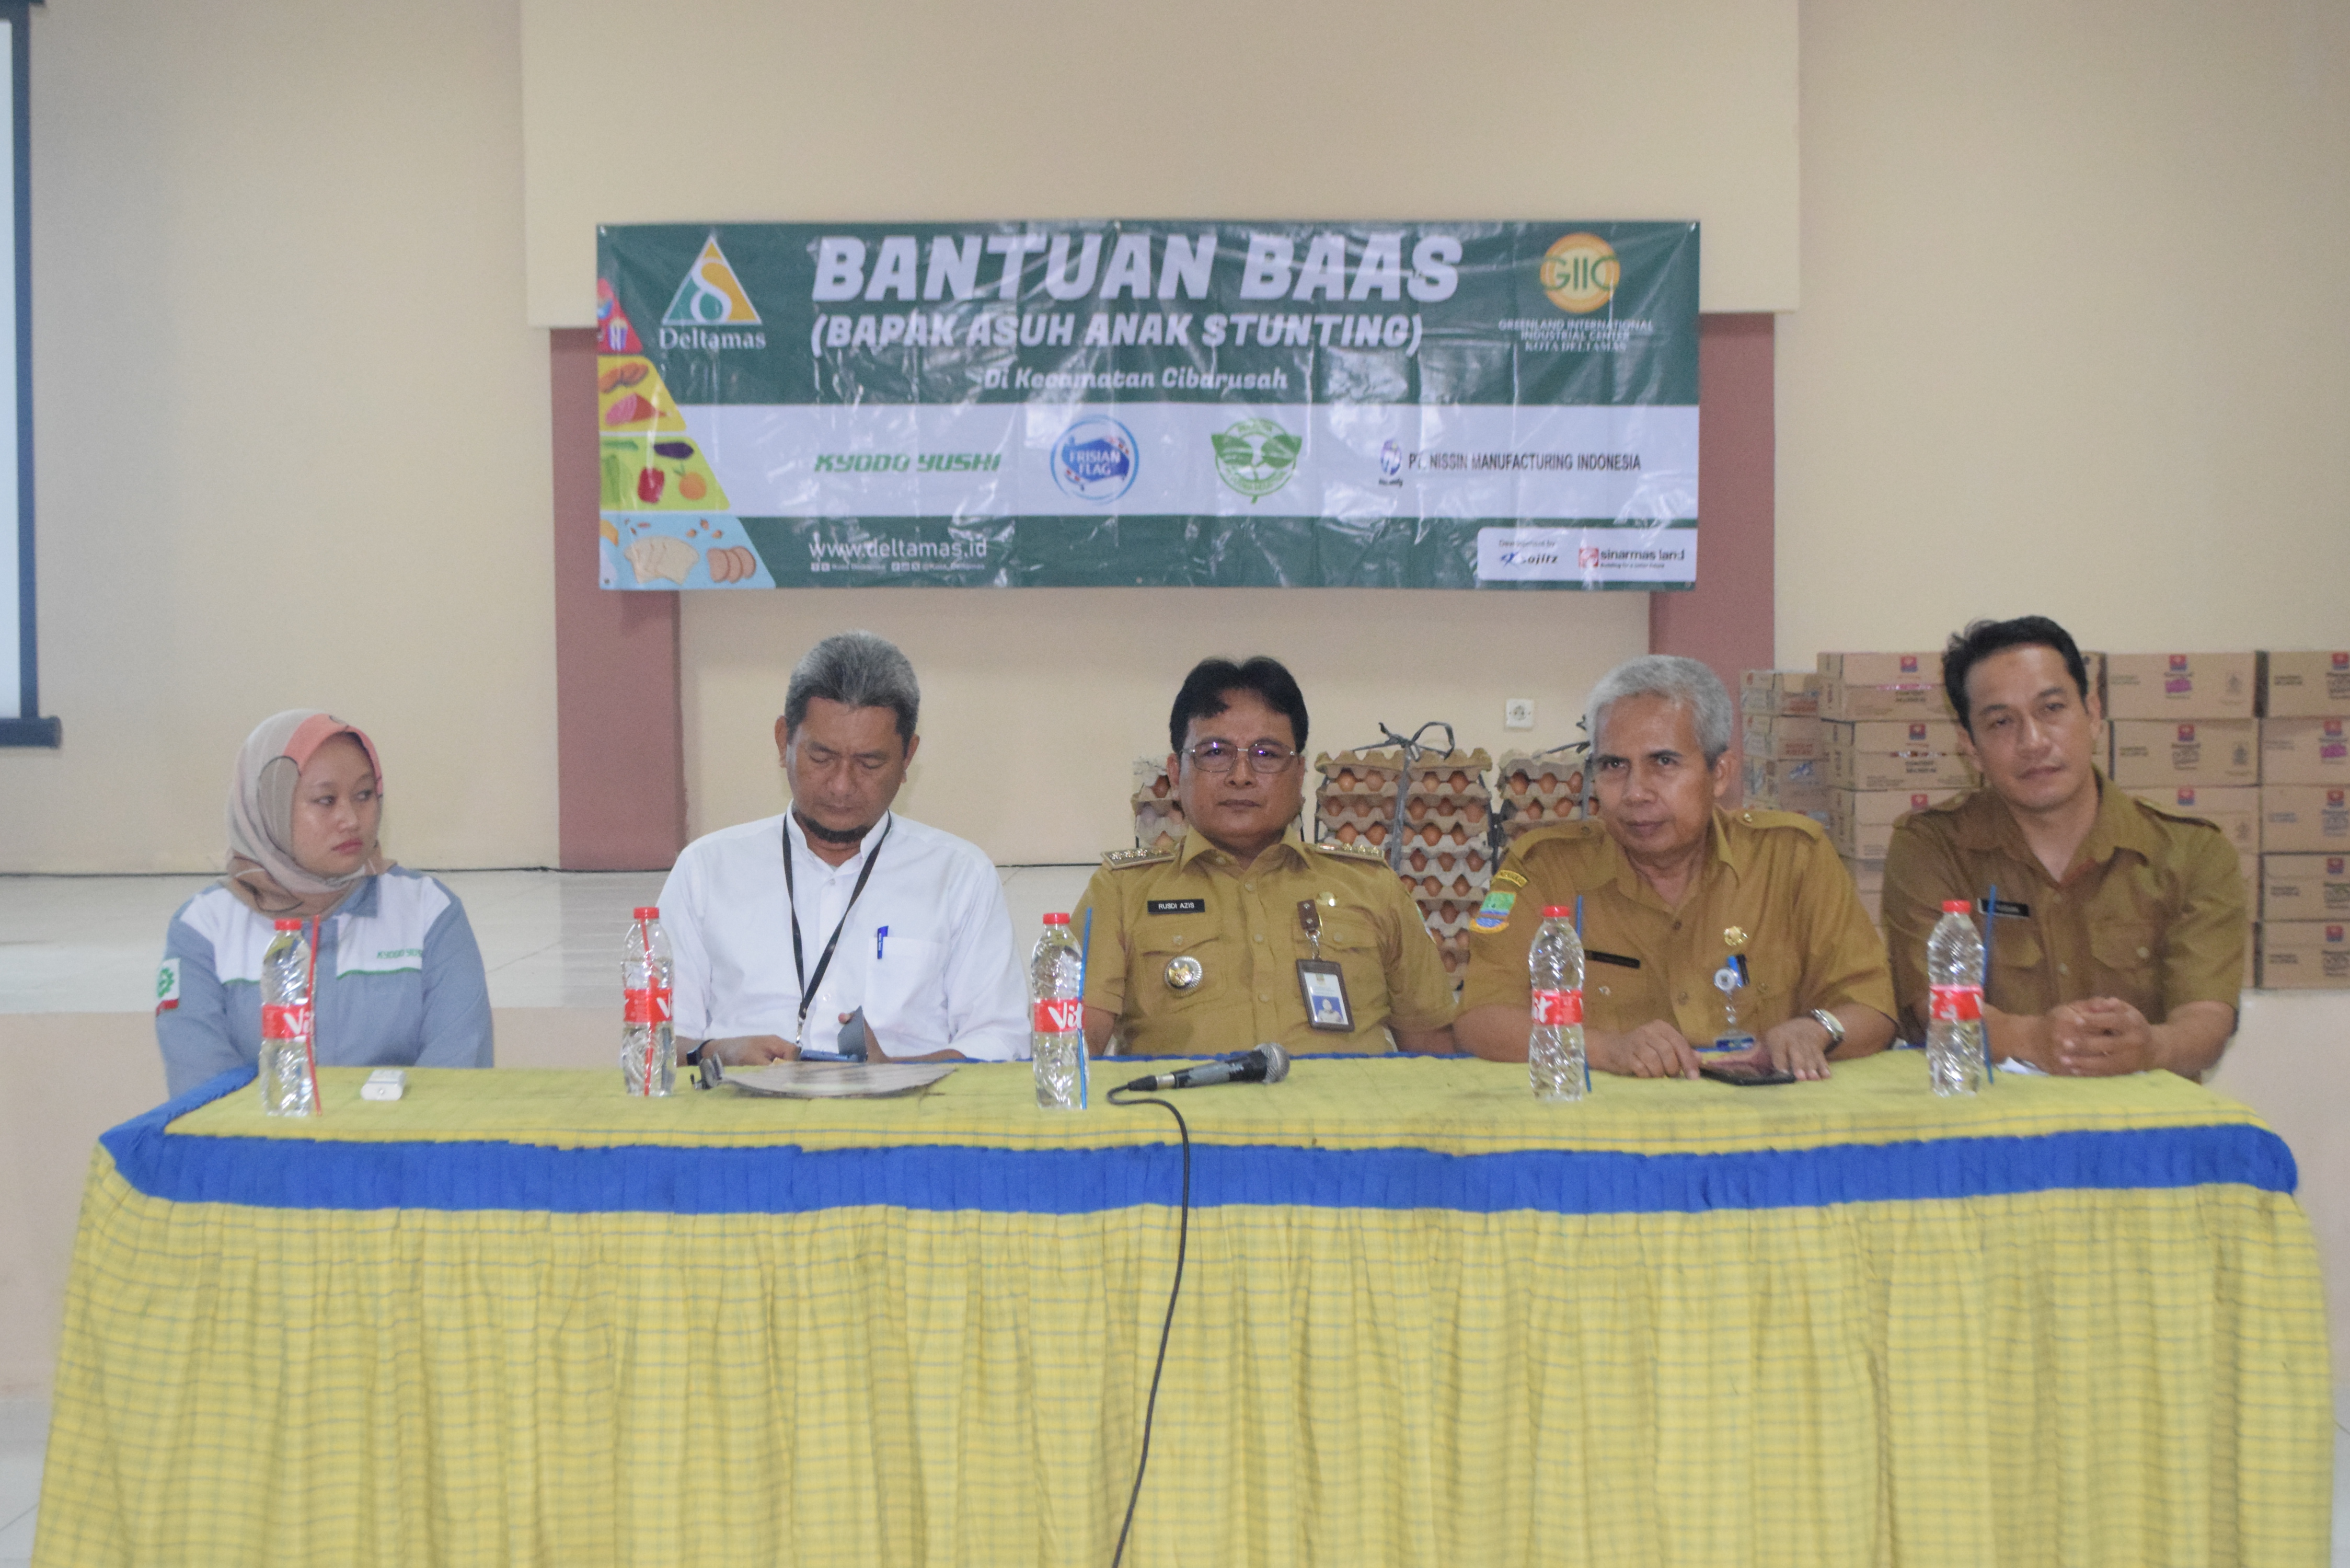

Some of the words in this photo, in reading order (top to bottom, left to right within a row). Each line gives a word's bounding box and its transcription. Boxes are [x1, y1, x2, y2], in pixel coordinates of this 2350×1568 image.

[812, 234, 1217, 302] BANTUAN
[1239, 232, 1462, 303] BAAS
[1542, 255, 1617, 291] GIIC
[660, 327, 767, 350] Deltamas
[811, 314, 954, 358] (BAPAK
[967, 314, 1075, 347] ASUH
[1085, 313, 1194, 347] ANAK
[1202, 314, 1423, 358] STUNTING)
[984, 367, 1008, 389] Di
[1015, 367, 1155, 389] Kecamatan
[1161, 367, 1288, 389] Cibarusah
[814, 454, 911, 472] KYODO
[917, 453, 1001, 472] YUSHI
[1430, 453, 1467, 470] NISSIN
[1471, 453, 1573, 470] MANUFACTURING
[1576, 453, 1642, 470] INDONESIA
[809, 537, 988, 558] www.deltamas.id
[1600, 548, 1656, 561] sinarmas
[1520, 552, 1558, 565] ojitz
